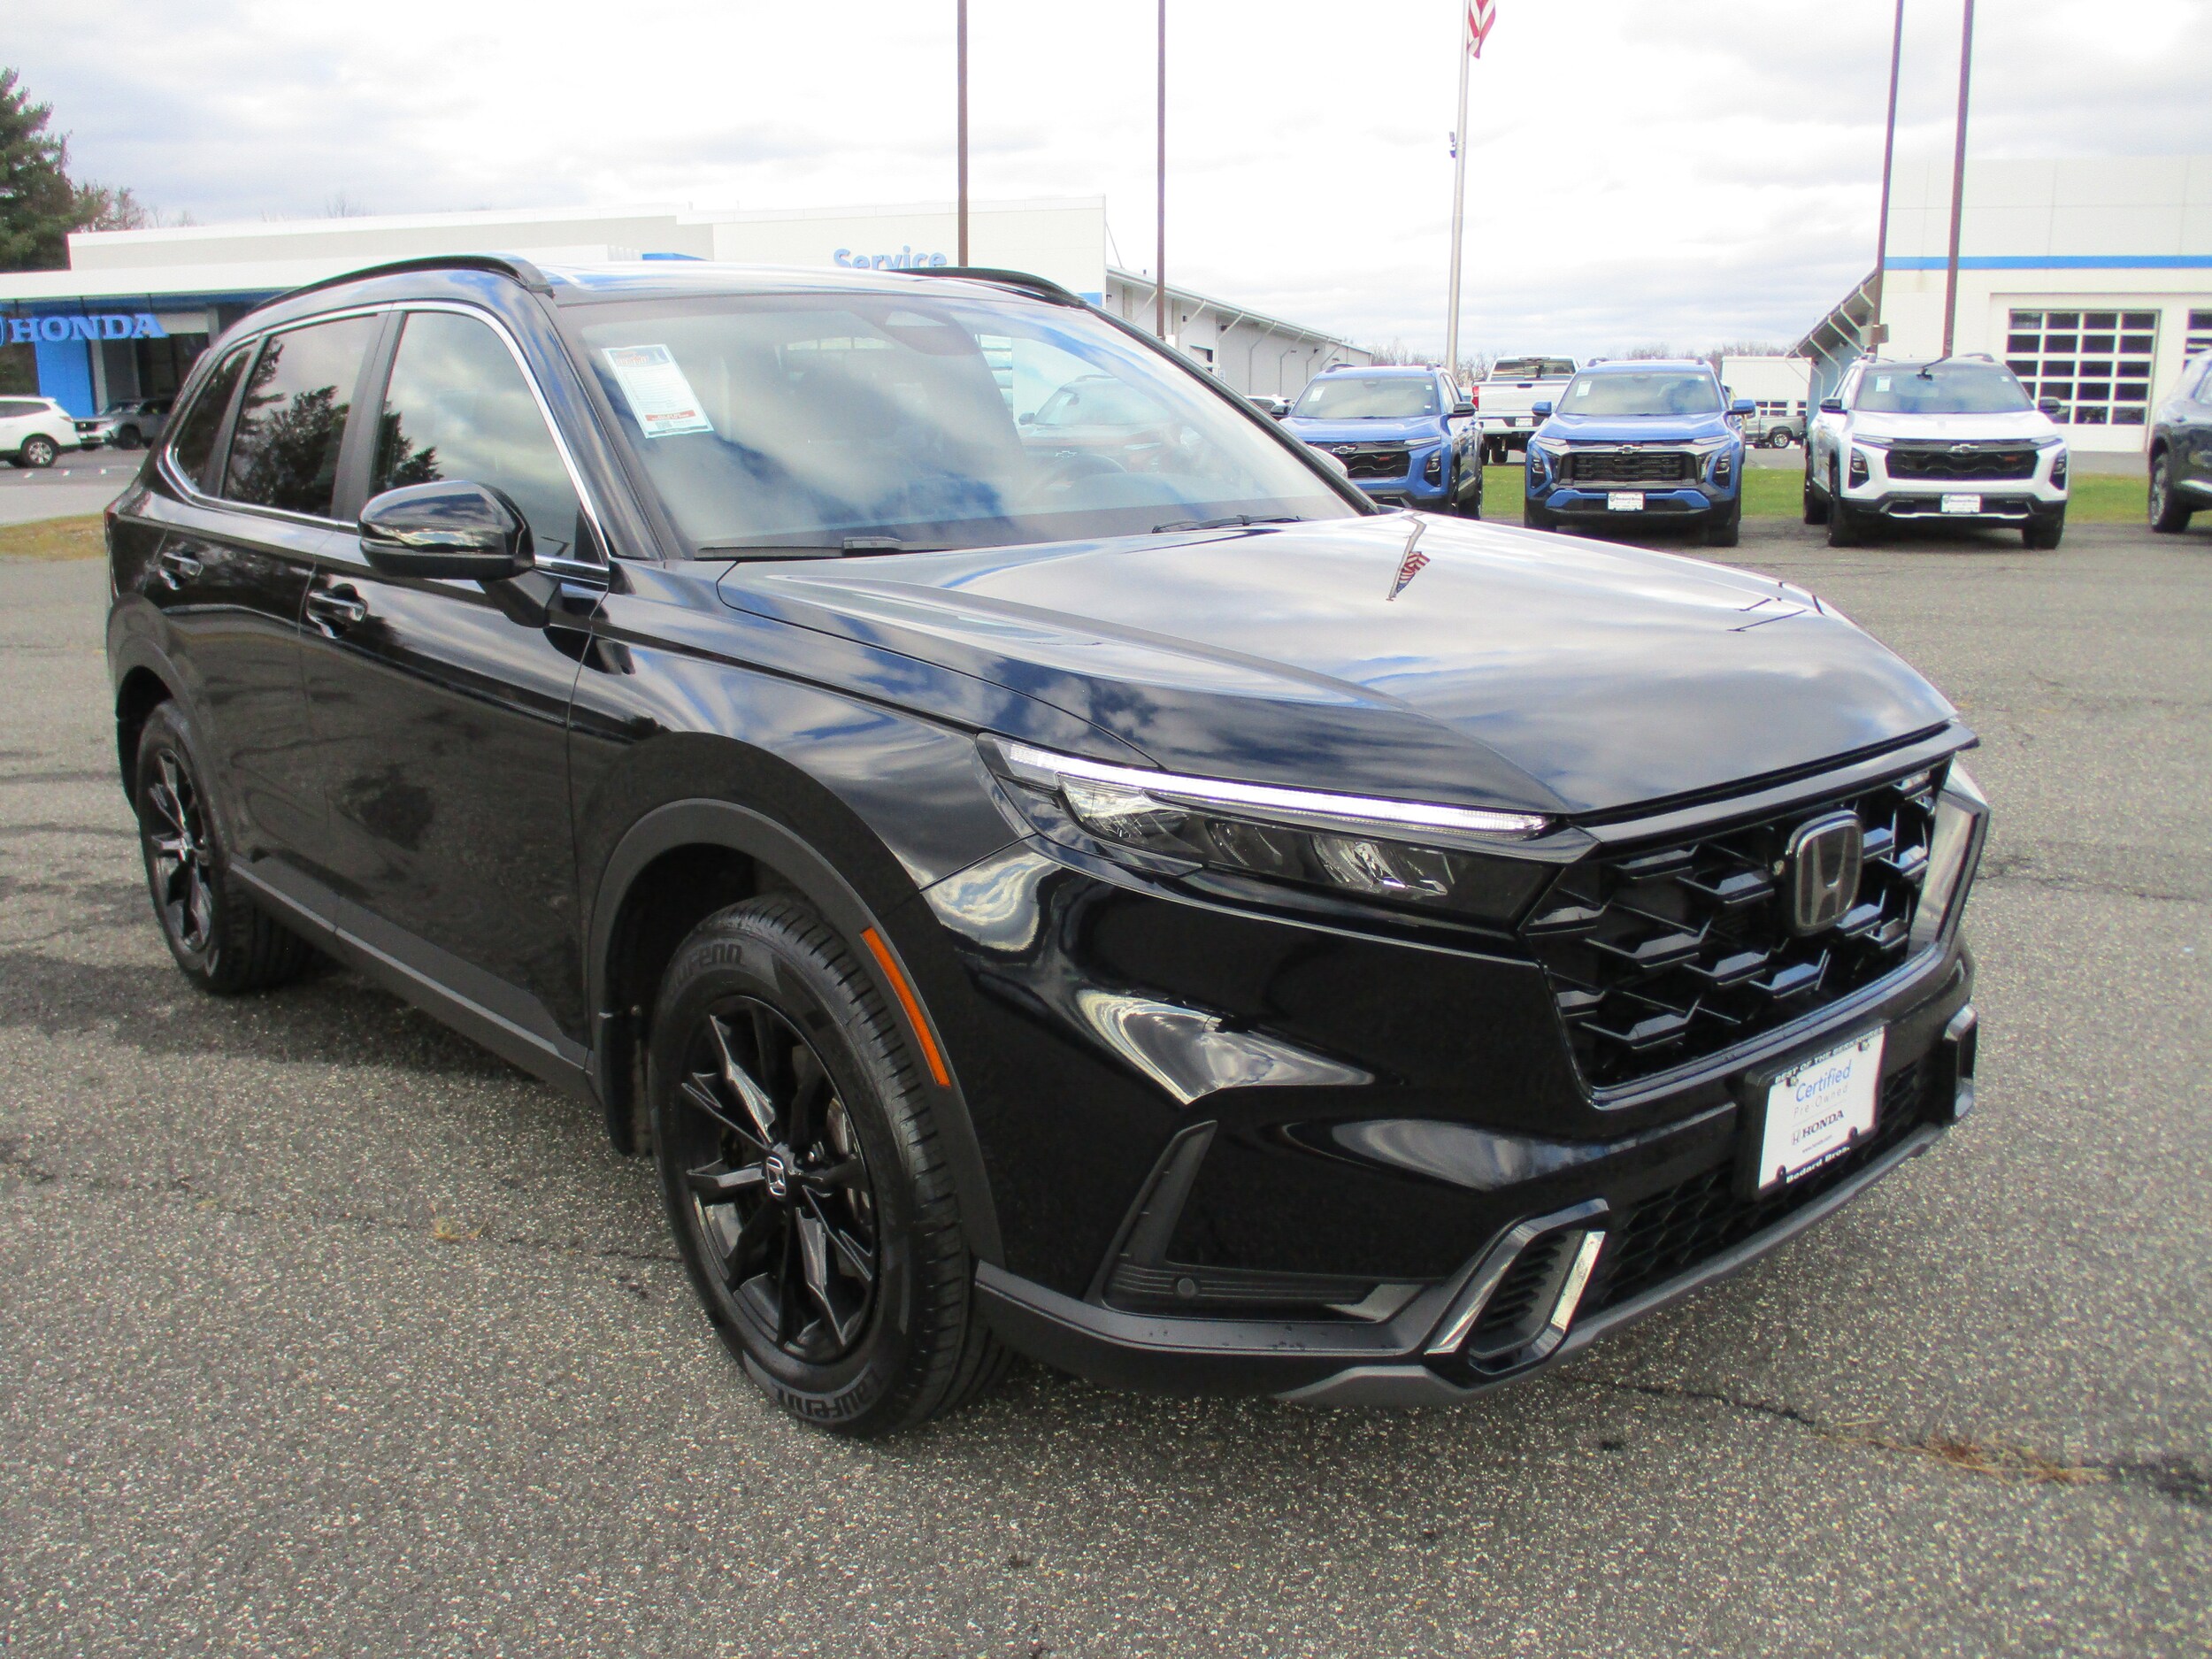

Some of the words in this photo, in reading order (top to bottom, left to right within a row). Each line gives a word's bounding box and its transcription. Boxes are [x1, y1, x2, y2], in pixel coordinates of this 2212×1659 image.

[833, 245, 947, 270] Service
[8, 313, 170, 342] HONDA
[1796, 1059, 1852, 1102] Certified
[1801, 1109, 1845, 1139] HONDA
